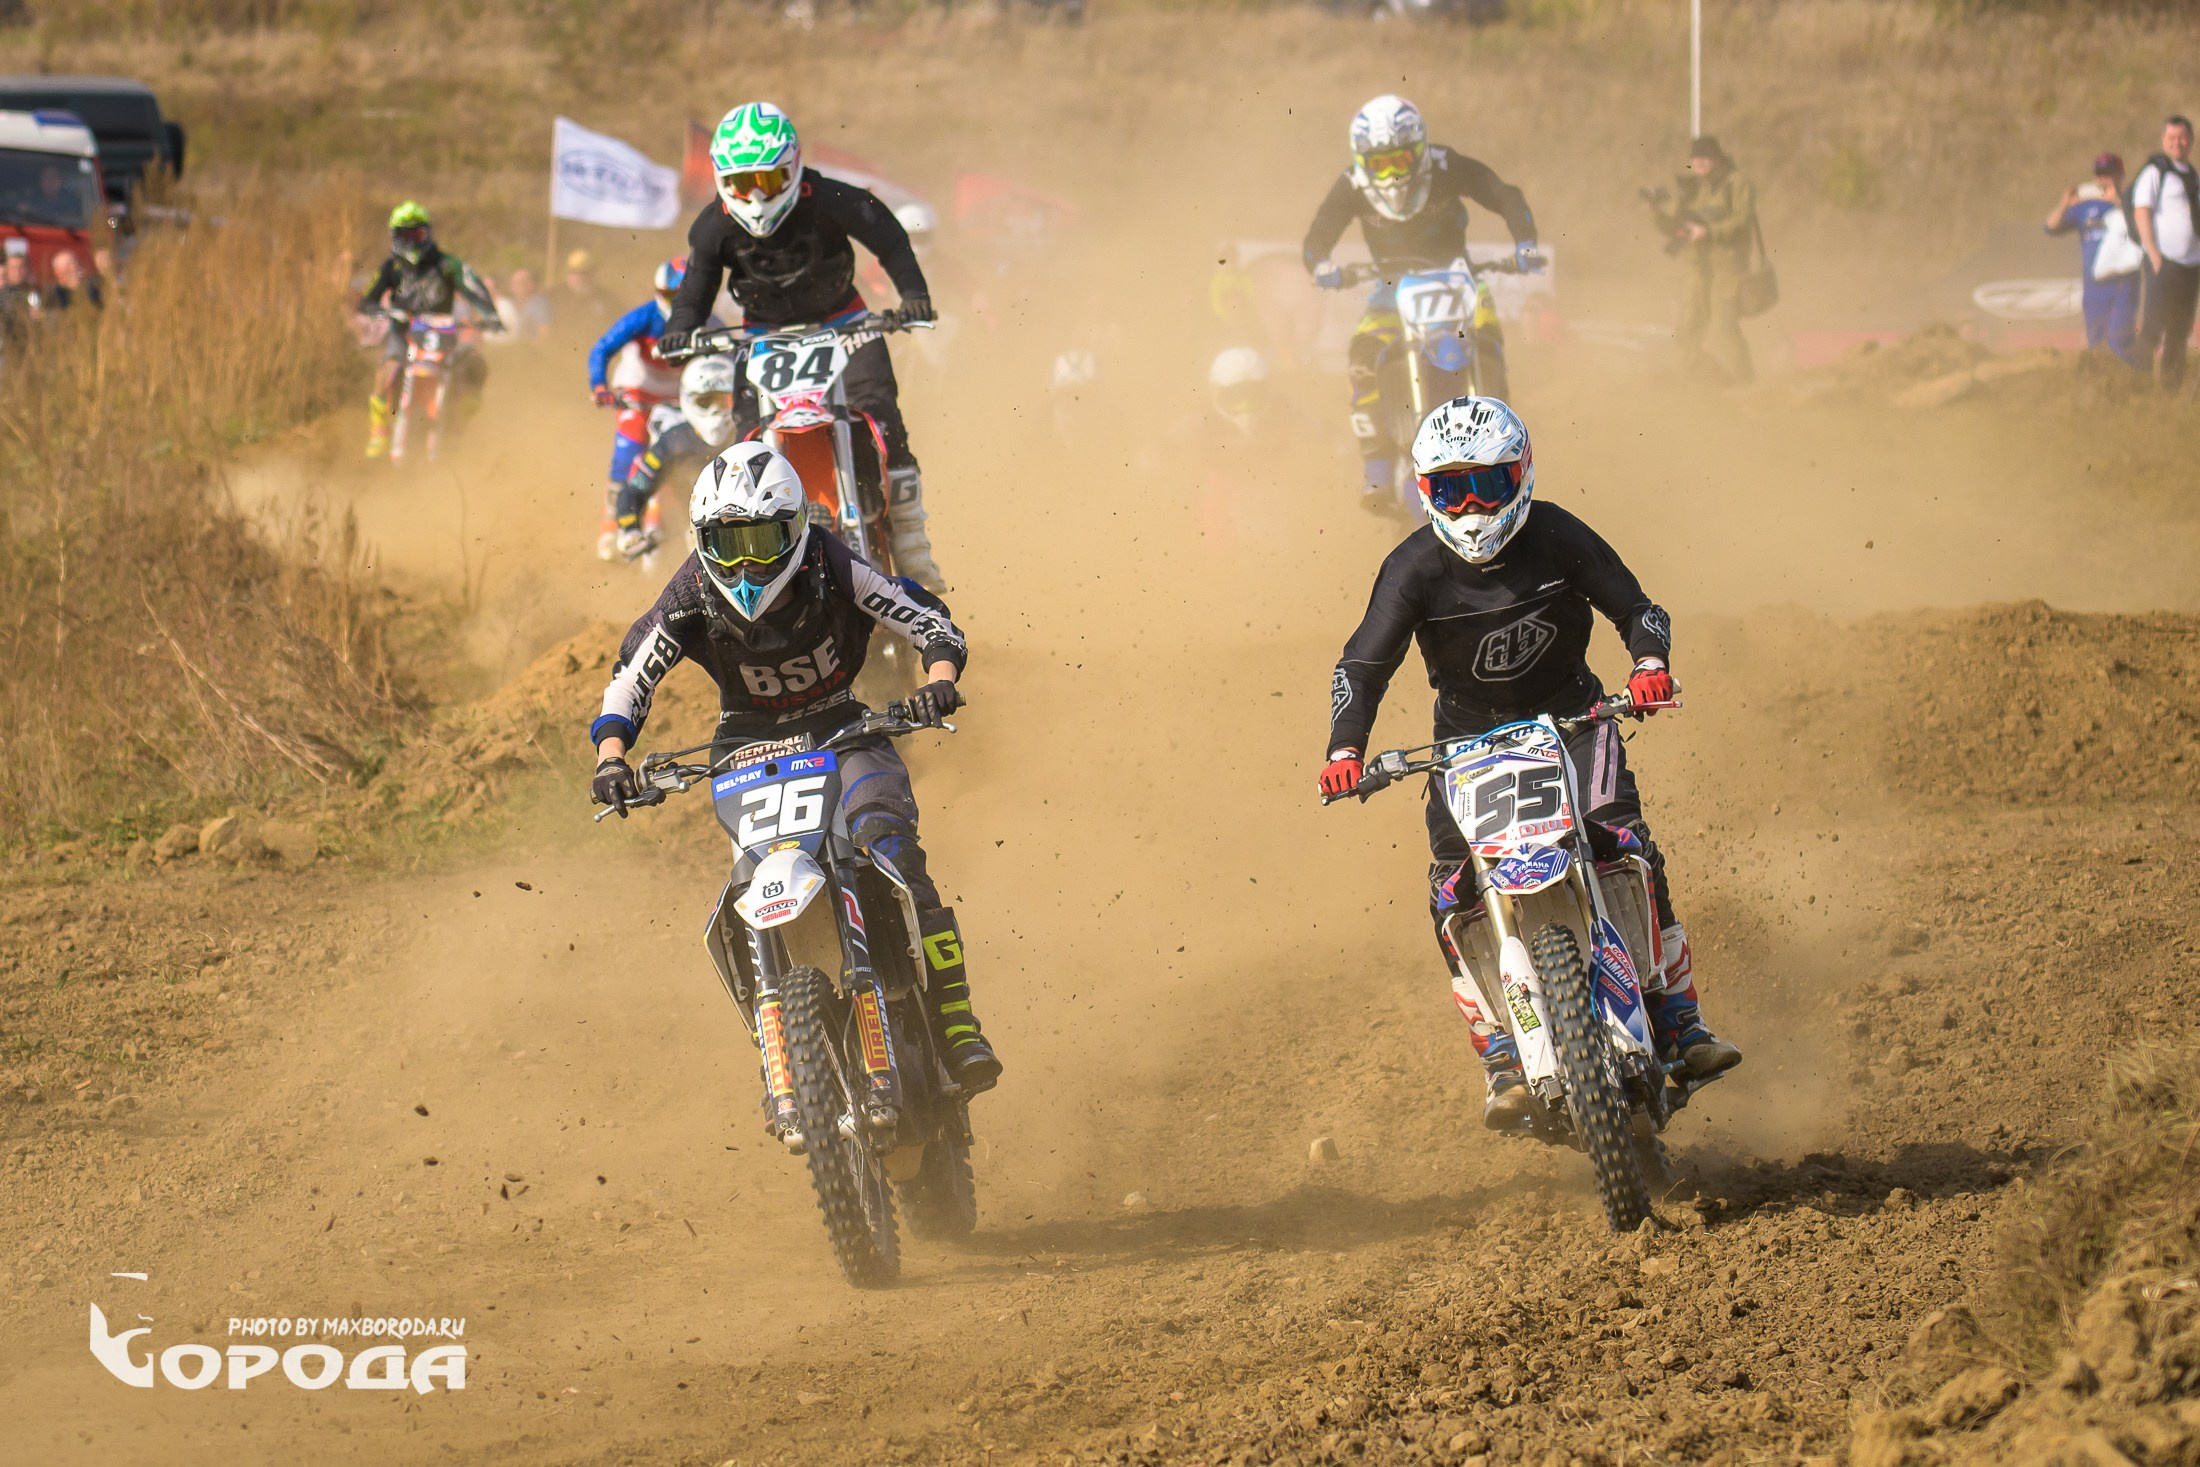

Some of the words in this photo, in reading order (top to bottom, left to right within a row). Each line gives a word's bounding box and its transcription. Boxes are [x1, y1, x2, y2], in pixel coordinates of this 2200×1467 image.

[760, 346, 834, 392] 84
[739, 635, 840, 697] BSE
[751, 671, 846, 710] RUSSIA
[738, 775, 827, 849] 26
[1475, 765, 1561, 842] 55
[1516, 860, 1550, 876] YAMAHA
[921, 929, 963, 971] G
[1601, 951, 1634, 990] YAMAHA
[1599, 976, 1633, 1005] BRAKING
[852, 990, 889, 1069] PIRELLI
